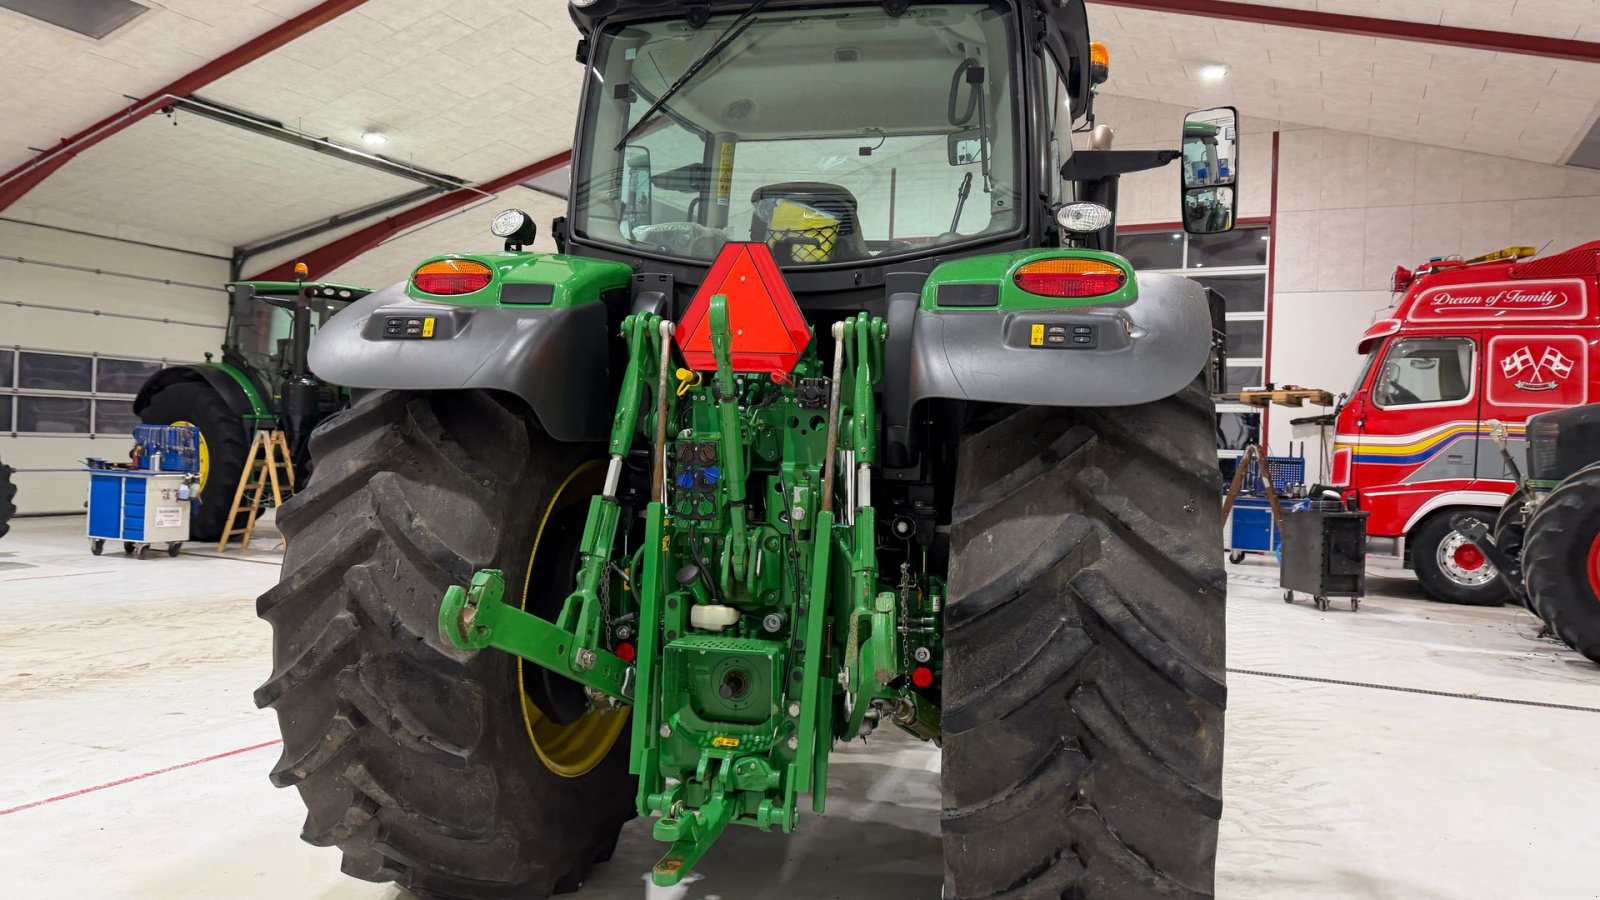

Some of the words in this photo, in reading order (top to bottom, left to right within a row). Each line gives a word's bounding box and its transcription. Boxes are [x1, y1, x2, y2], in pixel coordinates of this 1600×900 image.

[1430, 292, 1482, 306] Dream
[1485, 290, 1507, 307] of
[1503, 289, 1557, 306] Family
